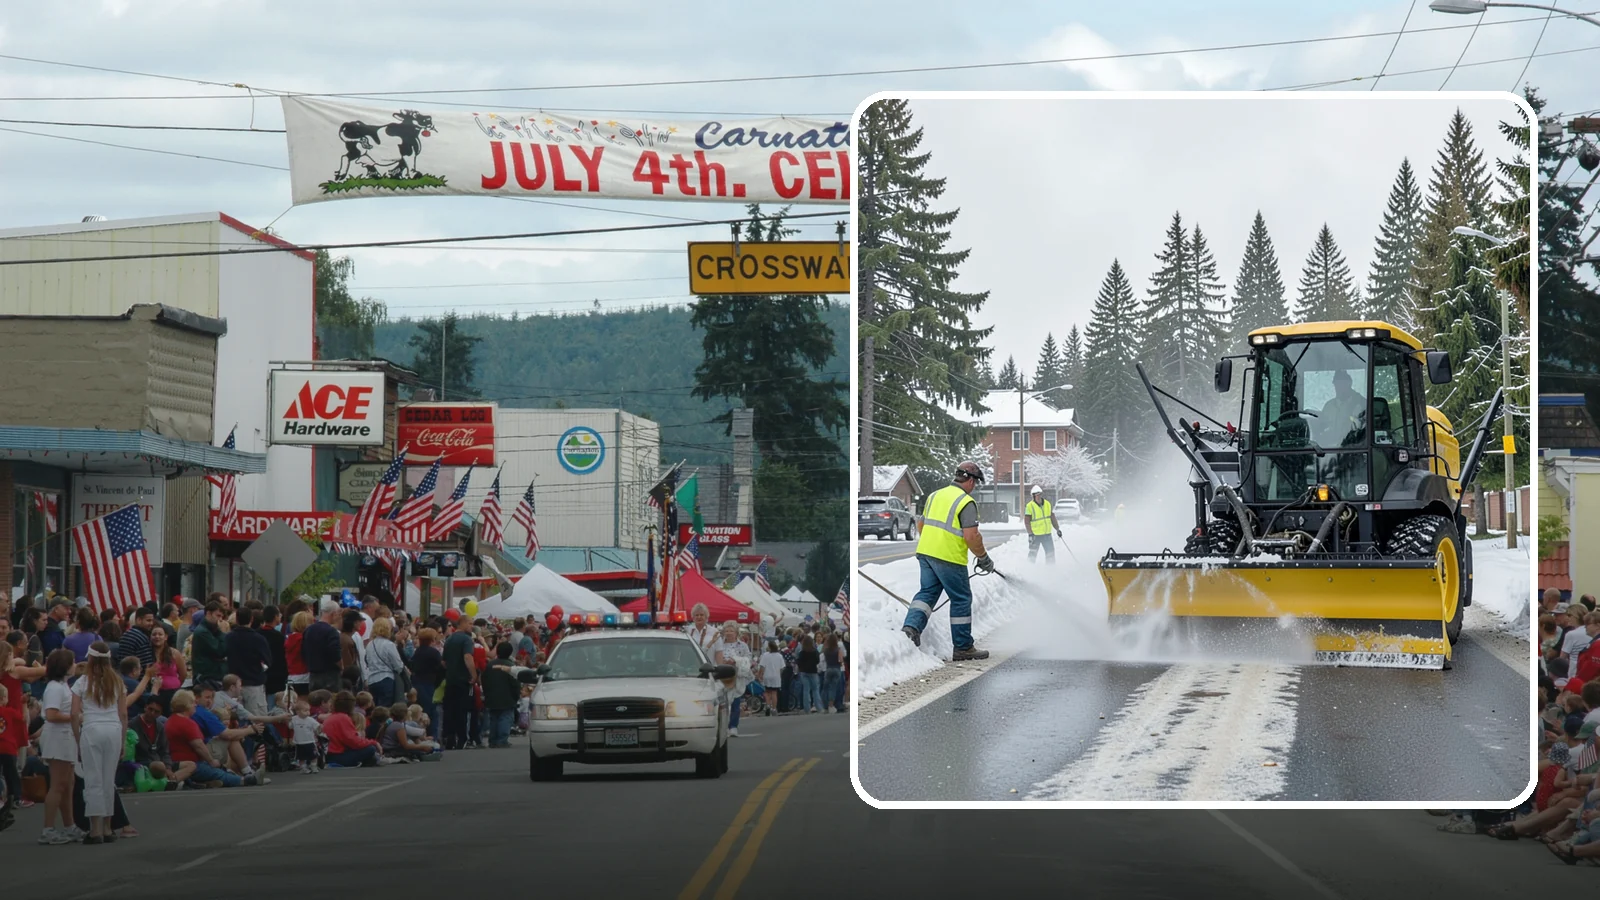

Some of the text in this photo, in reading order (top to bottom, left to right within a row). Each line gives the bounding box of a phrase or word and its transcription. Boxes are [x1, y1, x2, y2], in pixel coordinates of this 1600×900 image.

[481, 141, 604, 192] JULY
[632, 150, 746, 197] 4th.
[697, 254, 850, 279] CROSSWA
[282, 380, 373, 419] ACE
[406, 409, 452, 421] CEDAR
[283, 421, 371, 436] Hardware
[416, 428, 477, 446] Coca-Cola
[354, 467, 385, 480] Simpl
[95, 485, 124, 495] Vincent
[126, 486, 136, 495] de
[138, 486, 155, 495] Paul
[688, 526, 741, 535] CRNATION
[699, 535, 730, 543] GLASS
